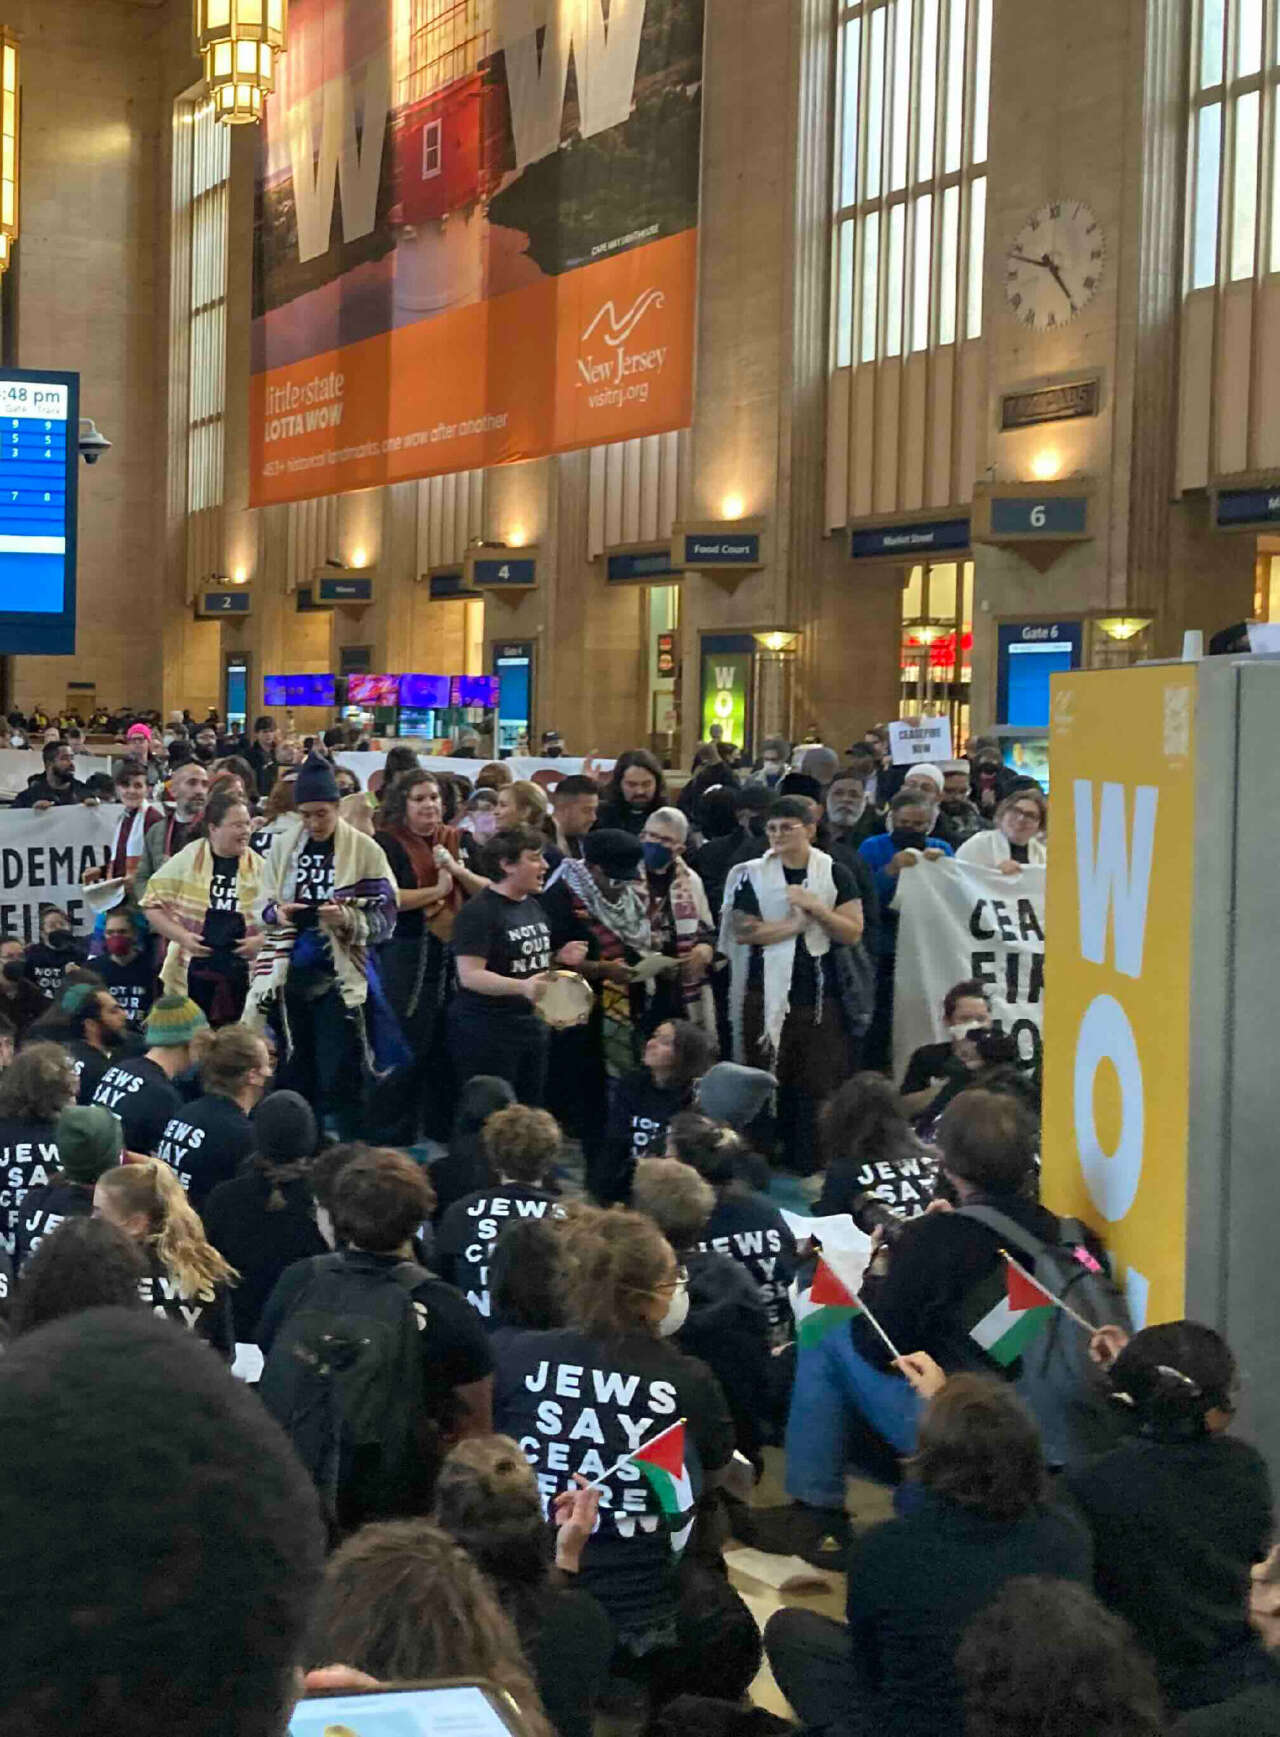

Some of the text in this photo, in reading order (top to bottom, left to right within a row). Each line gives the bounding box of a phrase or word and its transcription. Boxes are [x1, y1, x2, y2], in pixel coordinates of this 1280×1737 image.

[575, 347, 668, 387] New Jersey
[34, 391, 61, 406] pm
[12, 419, 19, 429] 9
[264, 401, 345, 443] LOTTA WOW
[12, 433, 19, 444] 5
[44, 435, 52, 445] 5
[402, 430, 430, 449] wow
[430, 421, 459, 443] after
[11, 448, 19, 458] 3
[44, 450, 52, 459] 4
[12, 491, 19, 501] 7
[1030, 505, 1047, 528] 6
[694, 543, 751, 556] Food Court
[497, 564, 511, 580] 4
[222, 597, 232, 609] 2
[1022, 624, 1059, 640] Gate 6
[2, 844, 112, 889] DEMA
[969, 898, 1045, 942] CEA
[34, 967, 62, 977] NOT
[511, 955, 550, 974] NAM
[39, 978, 62, 988] OU
[101, 1065, 144, 1093] EWS
[163, 1119, 206, 1149] EWS
[524, 1360, 678, 1415] JEWS
[535, 1400, 655, 1450] SAY
[519, 1435, 641, 1482] CEAS
[536, 1472, 648, 1513] FRE
